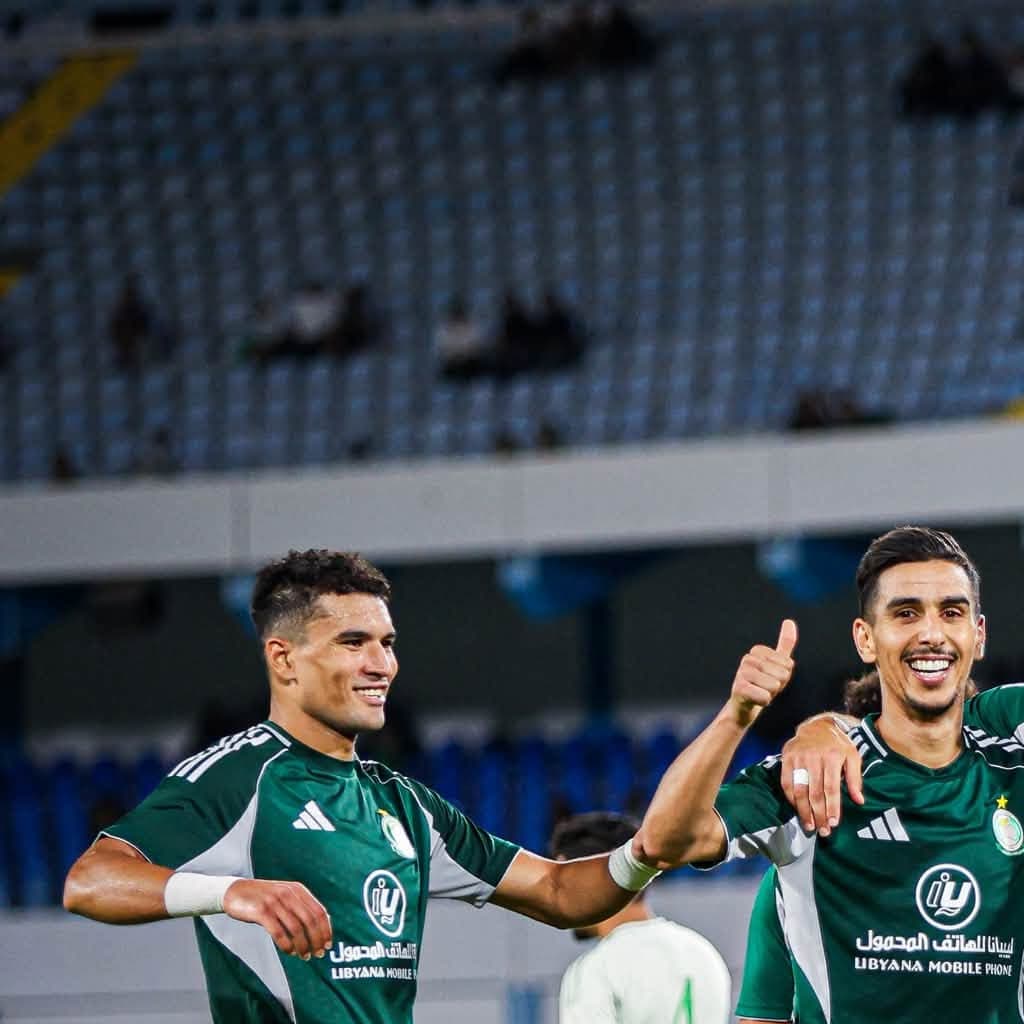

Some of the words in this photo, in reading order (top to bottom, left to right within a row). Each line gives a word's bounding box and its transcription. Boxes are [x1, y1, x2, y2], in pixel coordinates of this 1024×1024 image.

[855, 930, 929, 952] المحمول
[932, 934, 986, 953] للهاتف
[330, 941, 386, 963] المحمول
[331, 966, 386, 980] LIBYANA
[386, 967, 412, 980] MOBILE
[854, 957, 924, 973] LIBYANA
[928, 960, 982, 975] MOBILE
[985, 963, 1013, 977] PHONE
